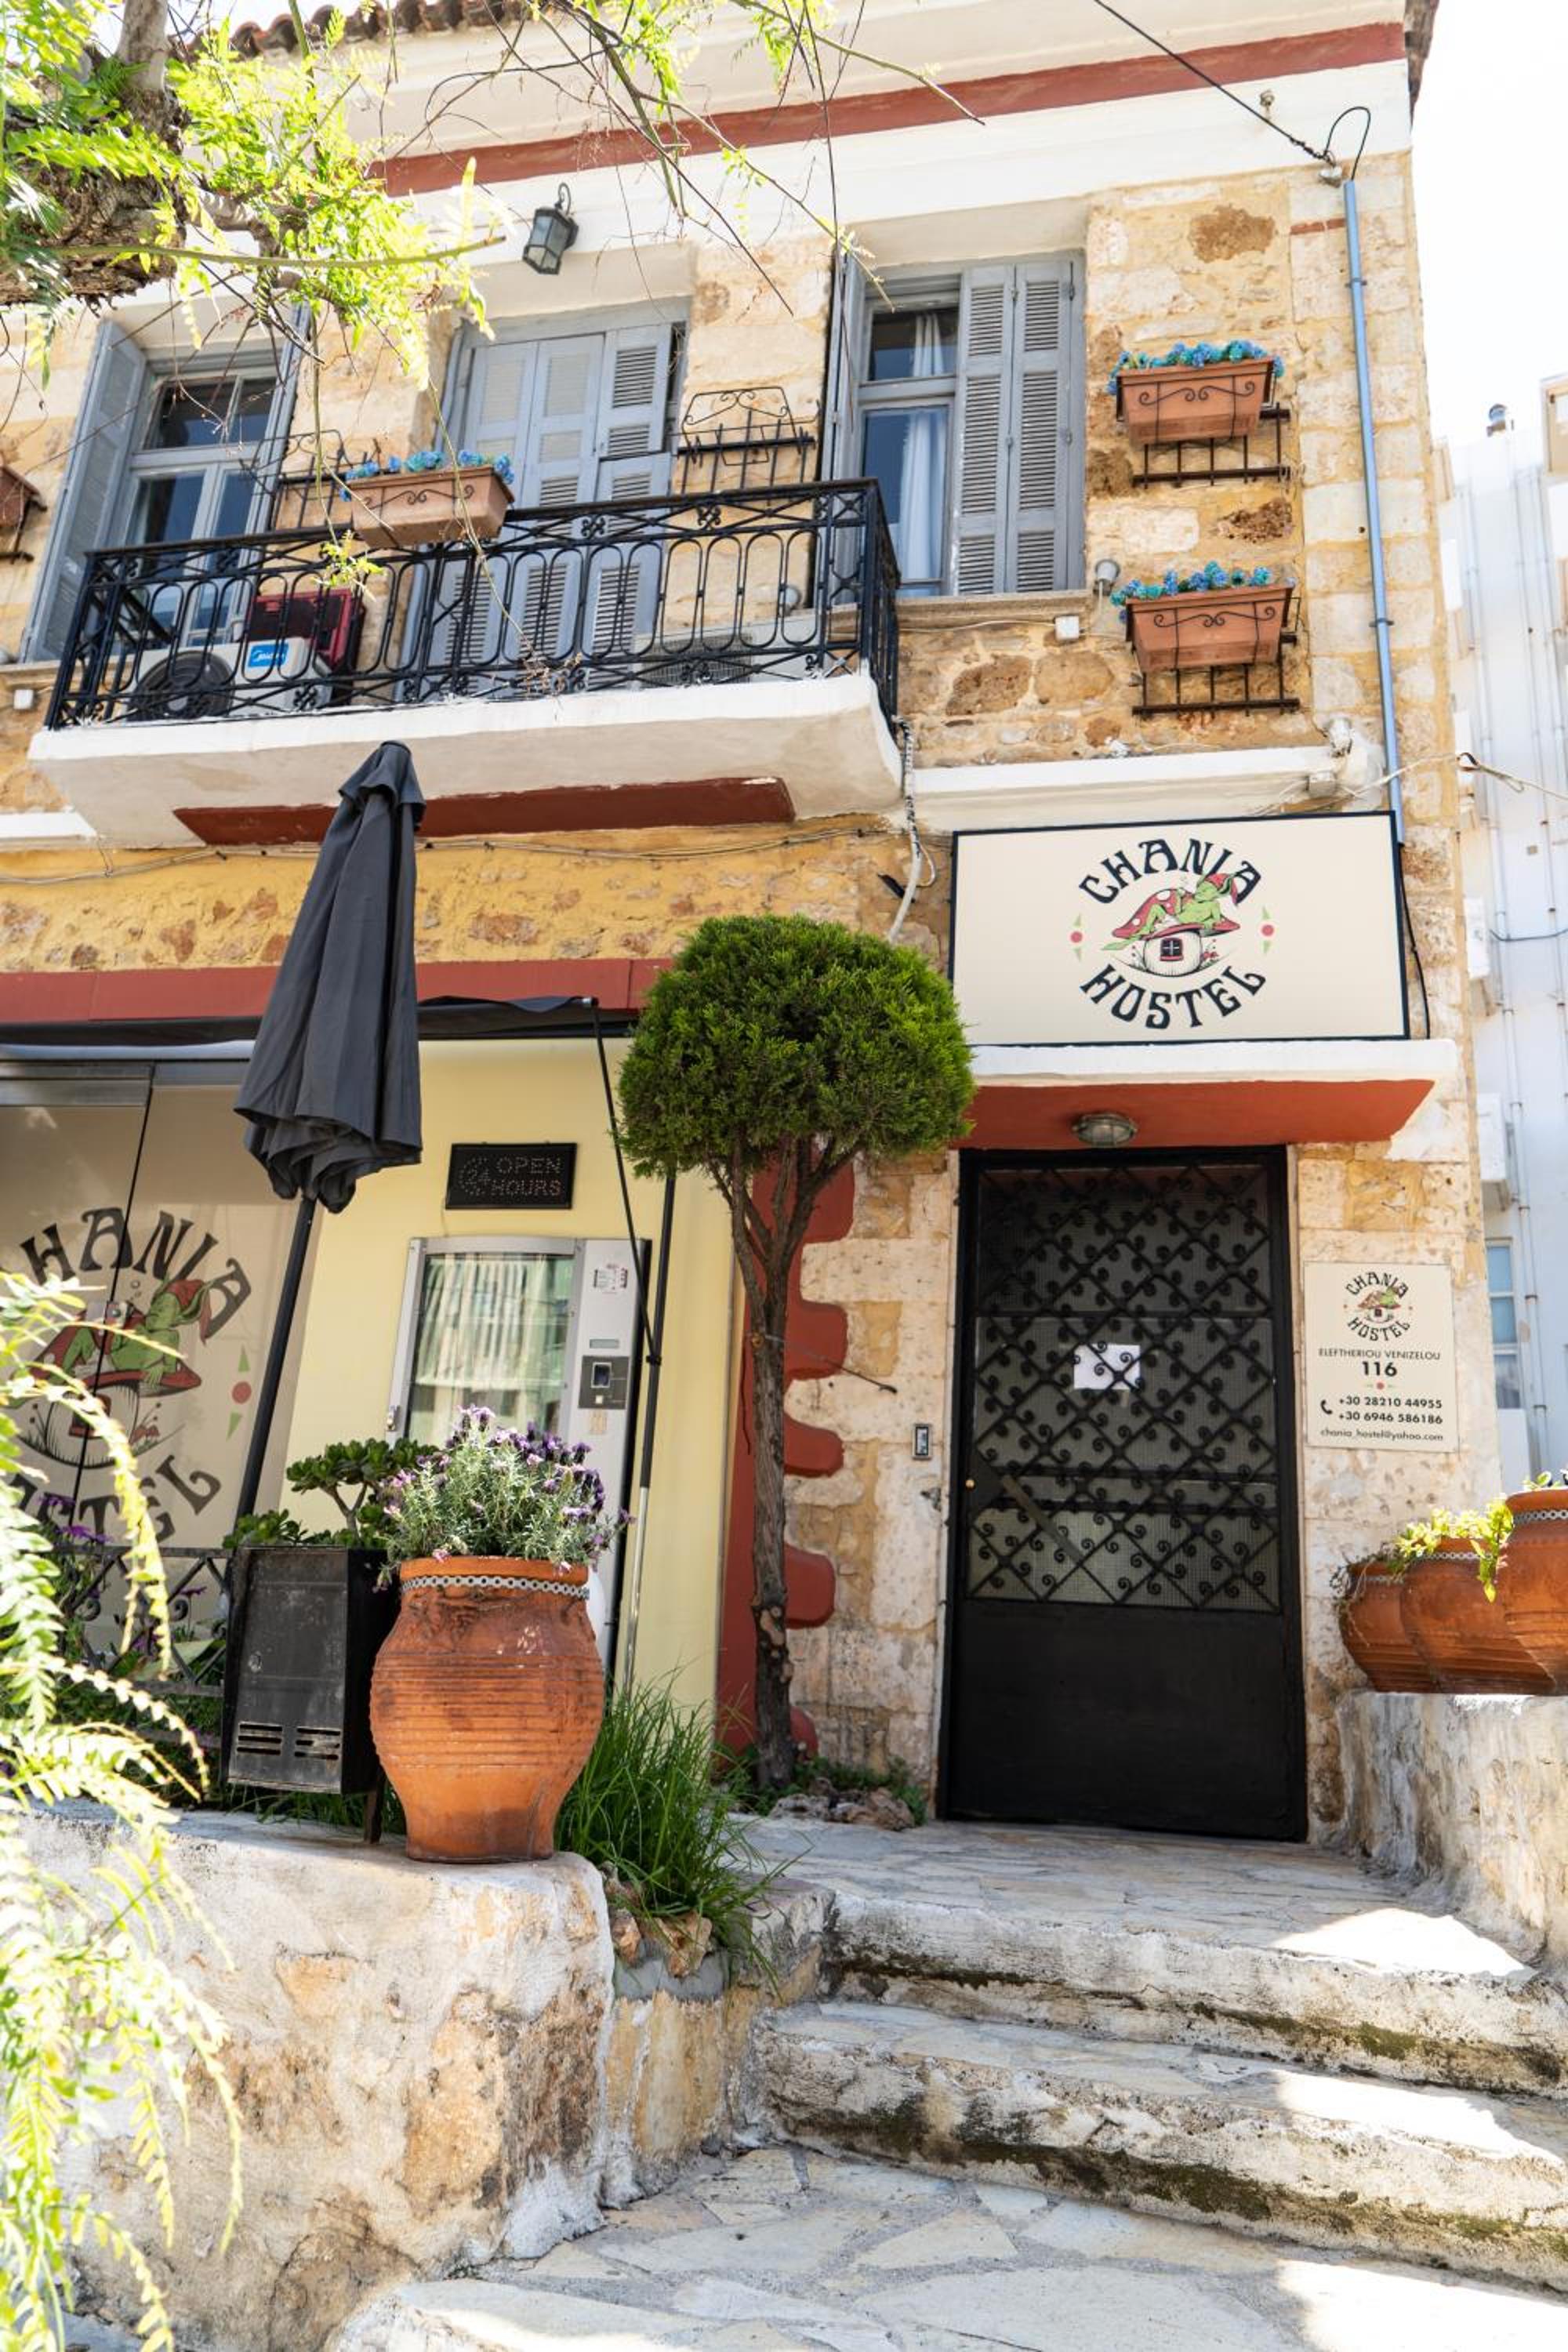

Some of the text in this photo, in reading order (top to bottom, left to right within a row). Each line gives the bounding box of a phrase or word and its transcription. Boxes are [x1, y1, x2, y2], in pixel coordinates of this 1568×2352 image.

[1079, 838, 1262, 906] CHANIA
[1079, 963, 1267, 1030] HOSTEL
[496, 1156, 561, 1174] OPEN
[491, 1178, 561, 1196] HOURS
[0, 1207, 252, 1339] HANIA
[1345, 1271, 1409, 1298] CHANIA
[1347, 1316, 1411, 1341] HOSTEL
[1318, 1348, 1441, 1360] ELEFTHERIOU VENIZELOU
[1362, 1361, 1398, 1377] 116
[1339, 1396, 1443, 1409] +30 28210 44955
[1339, 1411, 1443, 1425] +30 6946 586186
